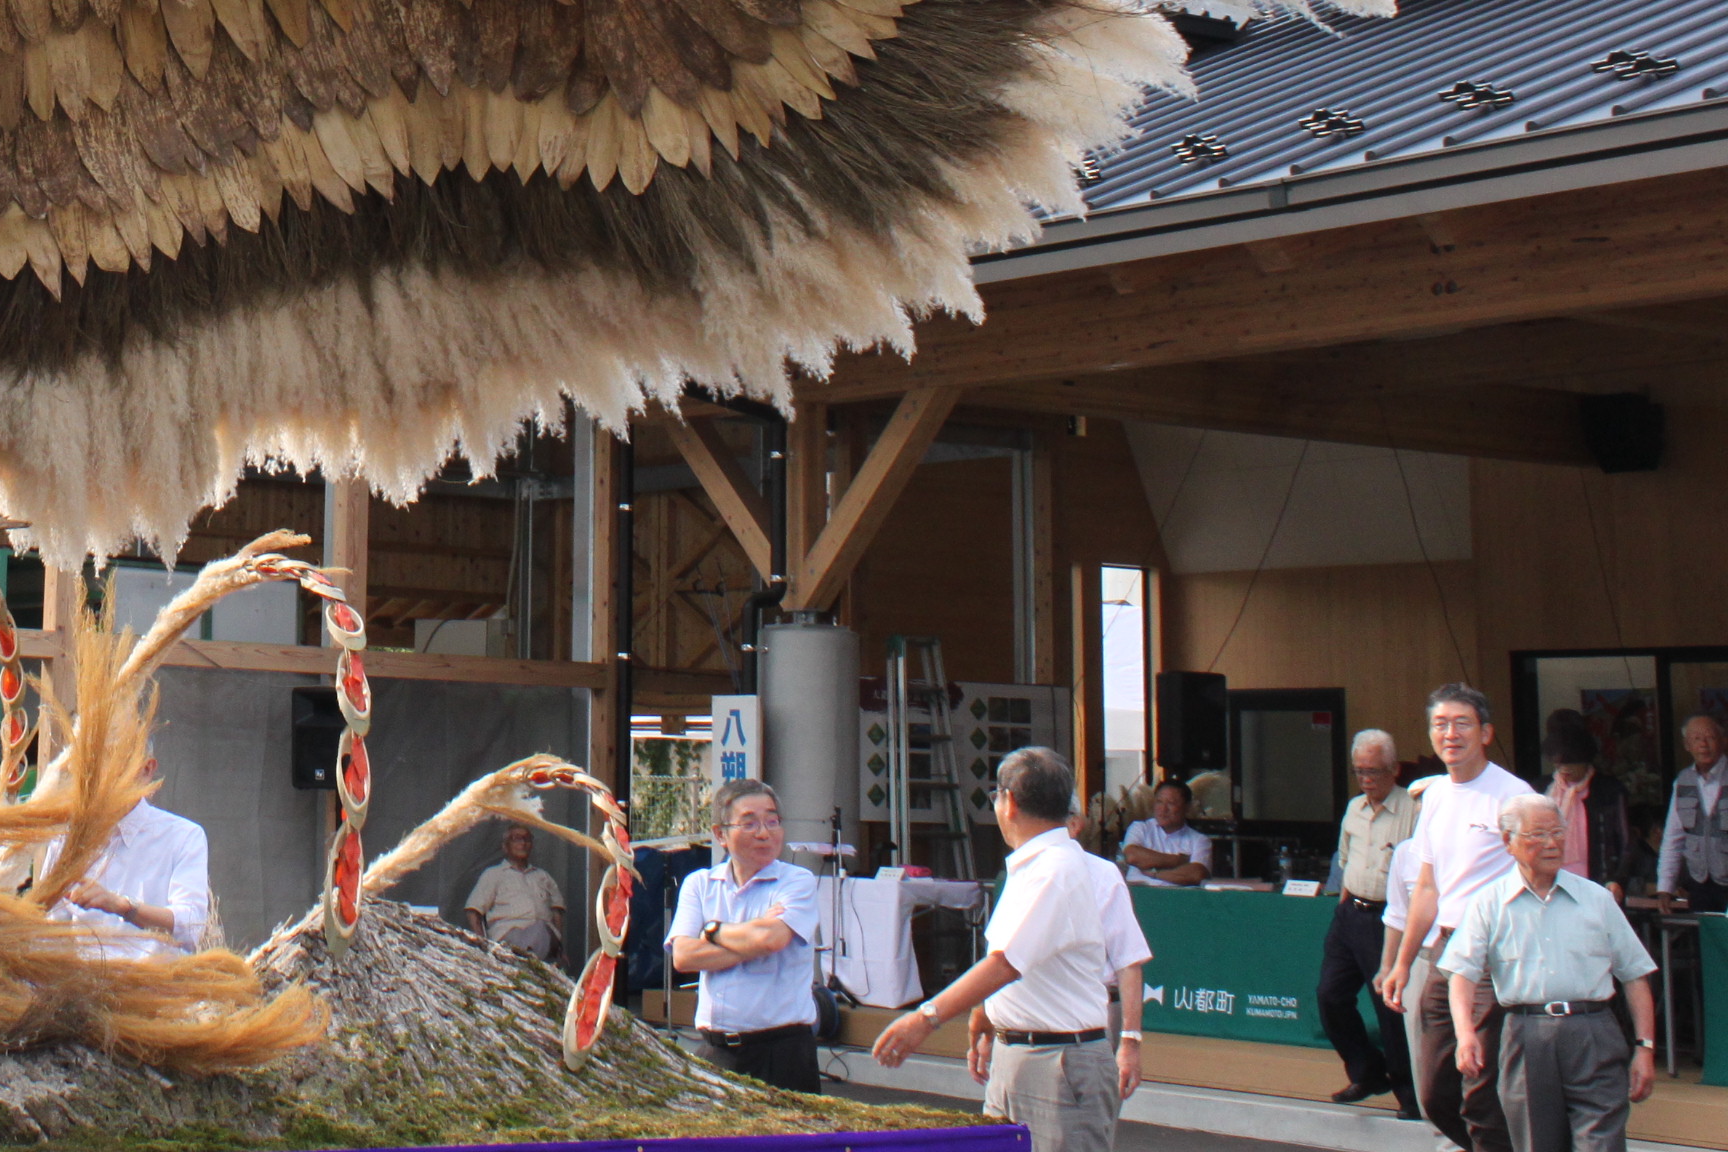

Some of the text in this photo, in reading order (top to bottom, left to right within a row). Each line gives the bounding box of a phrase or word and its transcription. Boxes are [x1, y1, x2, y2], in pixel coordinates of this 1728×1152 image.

[1174, 986, 1236, 1015] 山都町
[1247, 994, 1298, 1007] YAMATO-CHO
